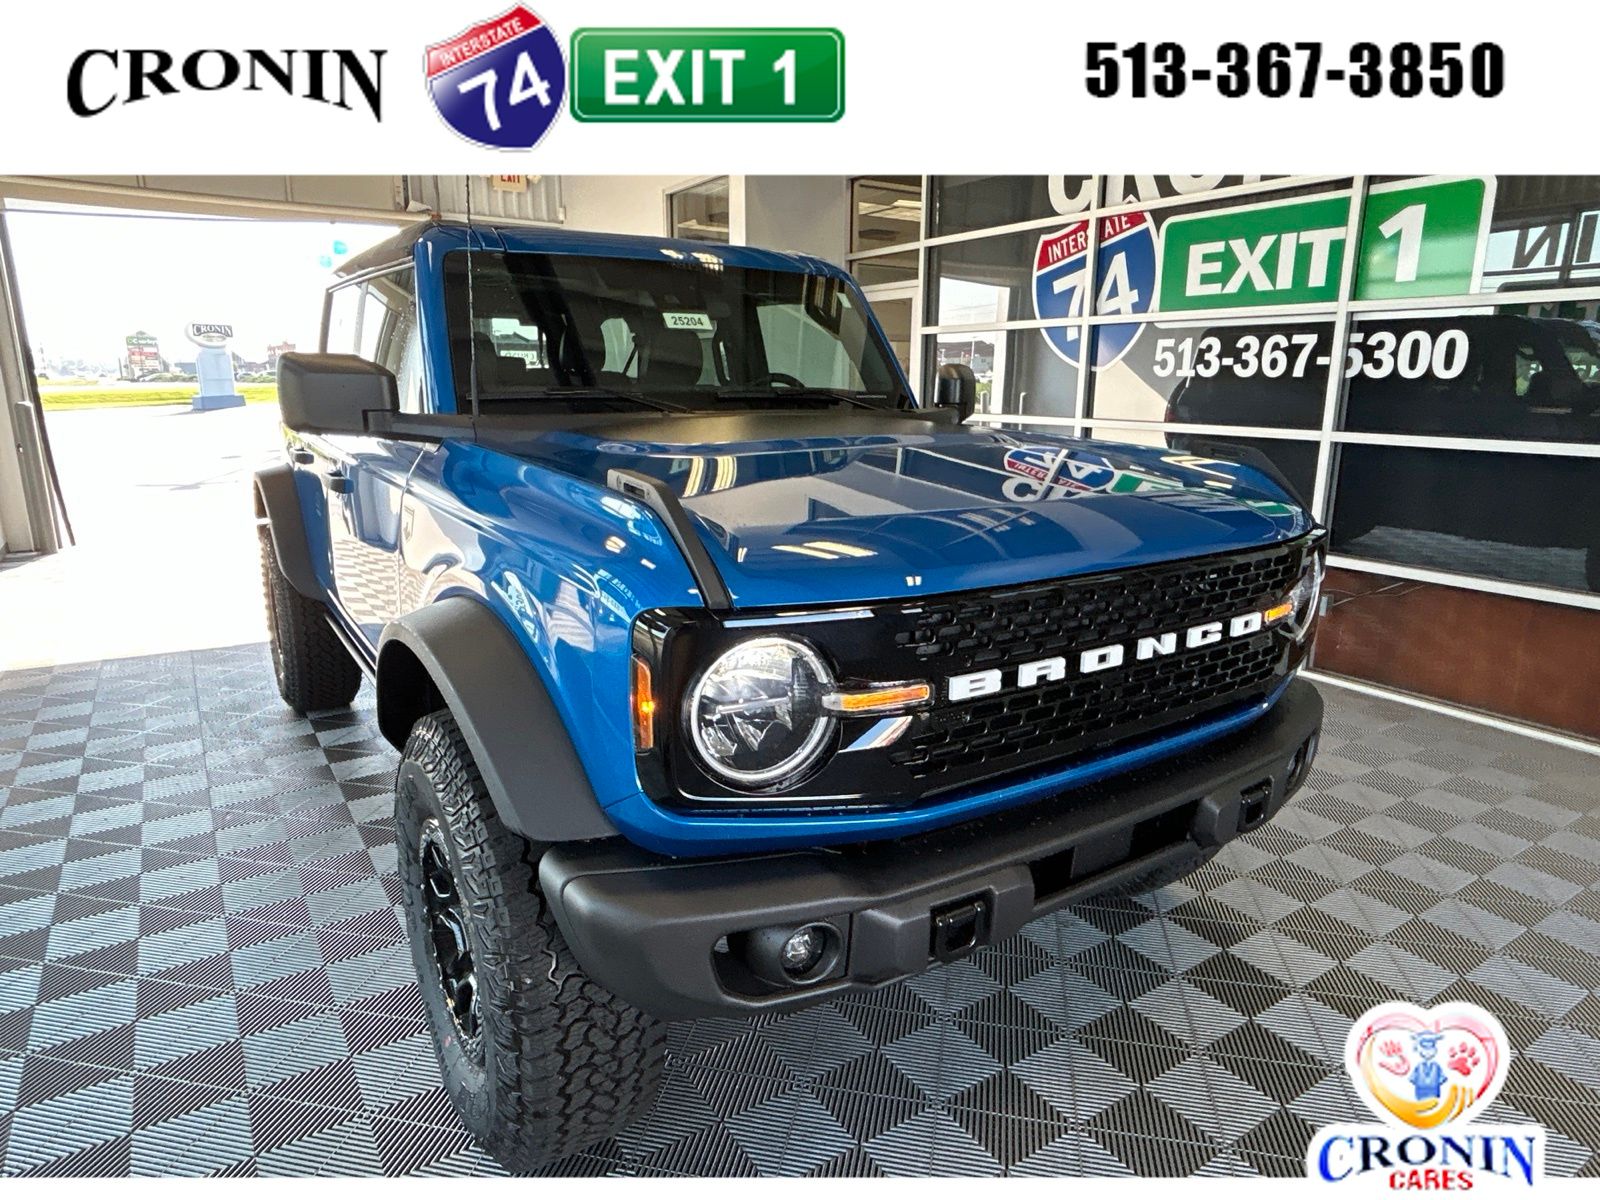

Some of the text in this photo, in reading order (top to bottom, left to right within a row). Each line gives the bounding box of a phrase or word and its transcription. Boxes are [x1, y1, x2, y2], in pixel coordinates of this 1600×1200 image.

[1185, 203, 1427, 297] EXIT 1
[192, 324, 233, 337] CRONIN
[671, 316, 704, 326] 25204
[1053, 251, 1139, 342] 74
[949, 612, 1262, 701] BRONCO
